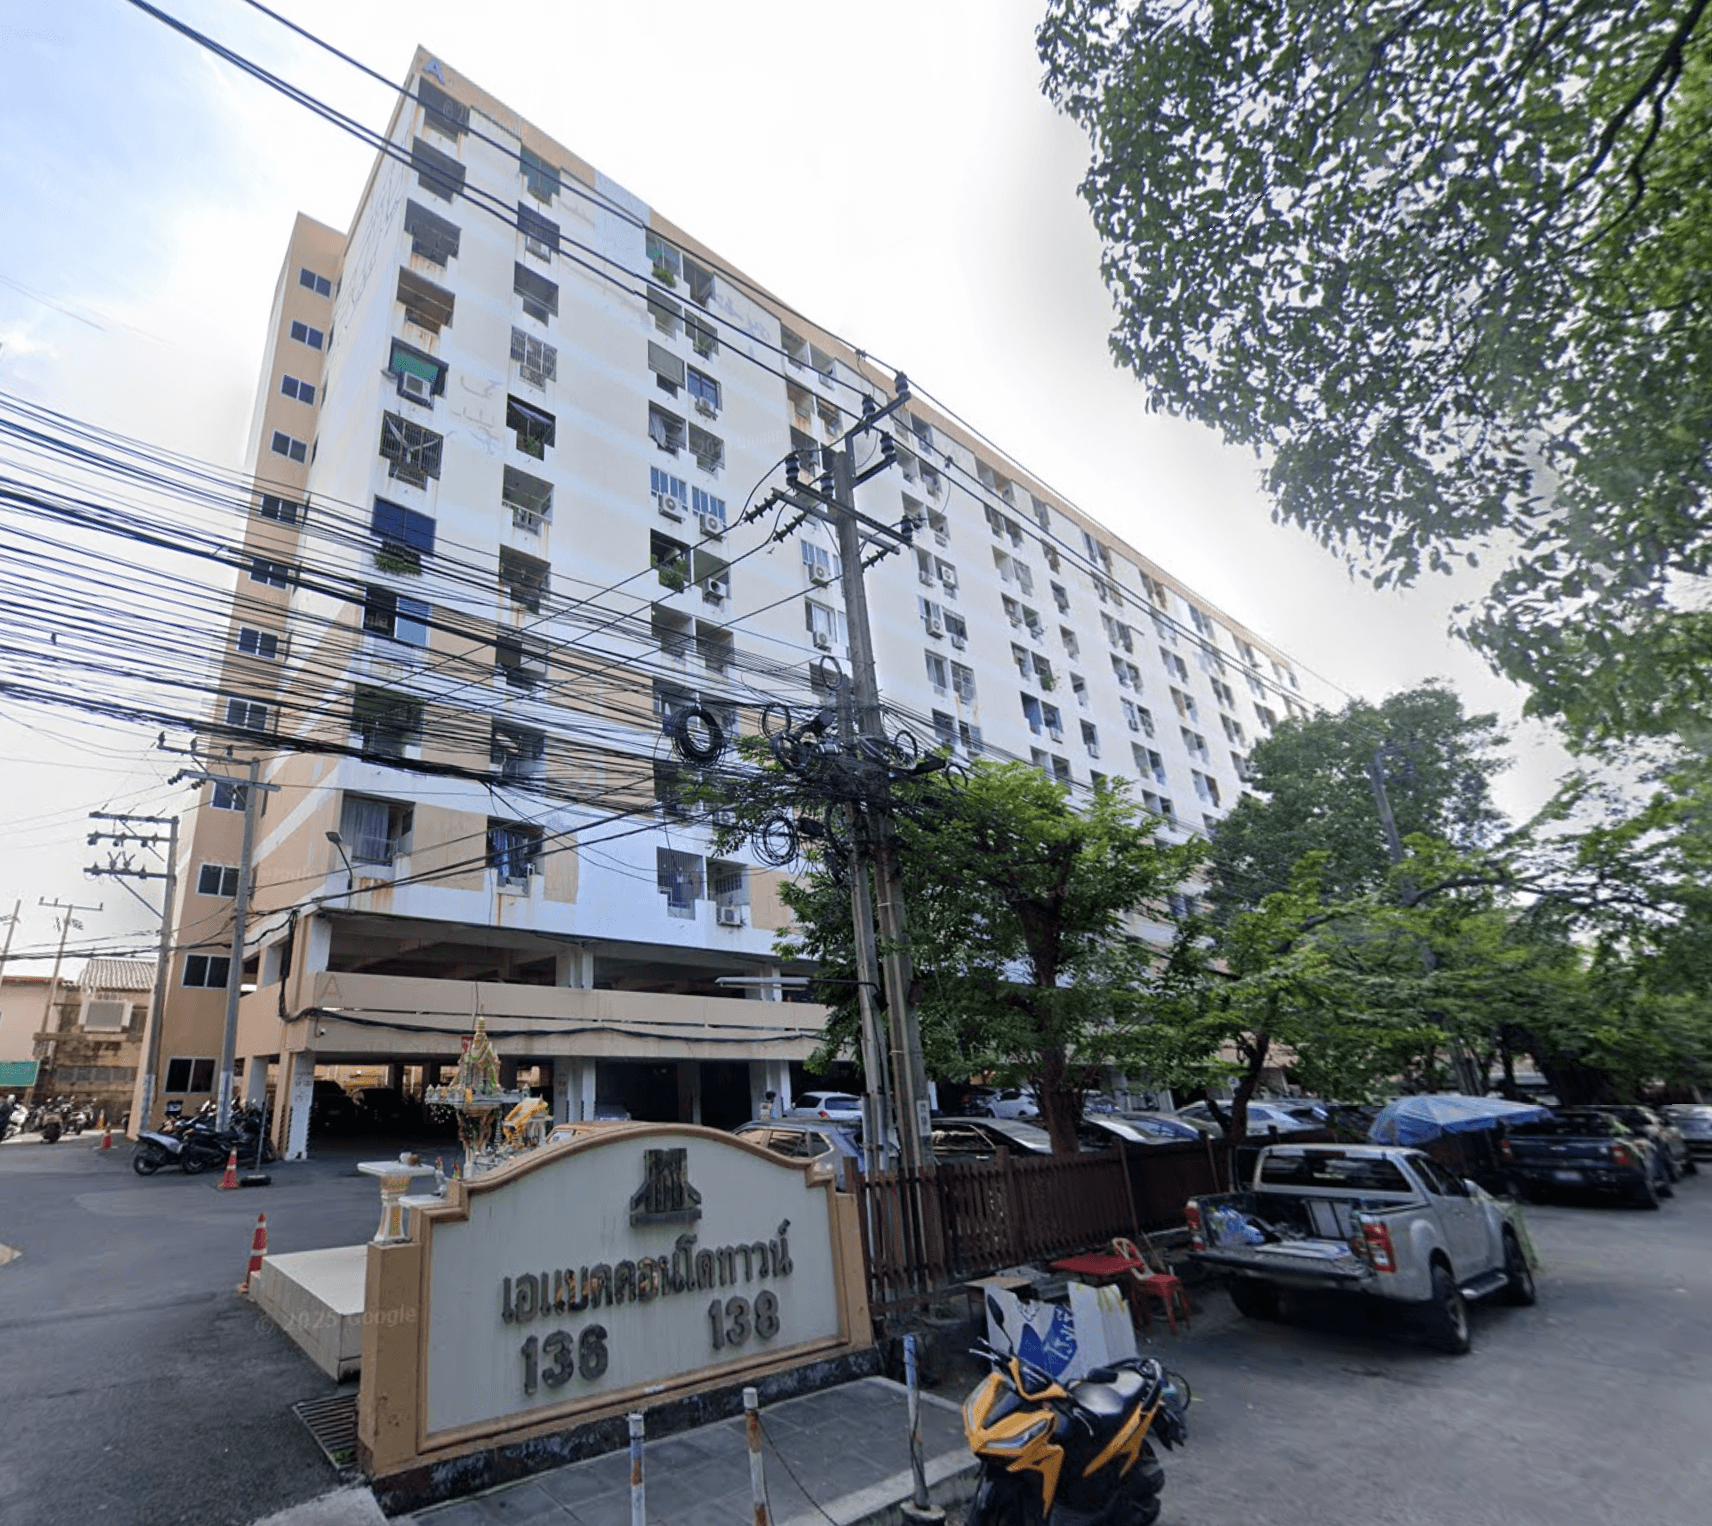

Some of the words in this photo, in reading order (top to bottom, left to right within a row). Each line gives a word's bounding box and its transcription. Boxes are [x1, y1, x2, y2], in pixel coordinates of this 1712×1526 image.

[421, 57, 446, 86] A
[320, 974, 343, 999] A
[501, 1218, 794, 1325] เอแบคคอนโดทาวน์
[521, 1324, 609, 1397] 136
[708, 1290, 781, 1351] 138
